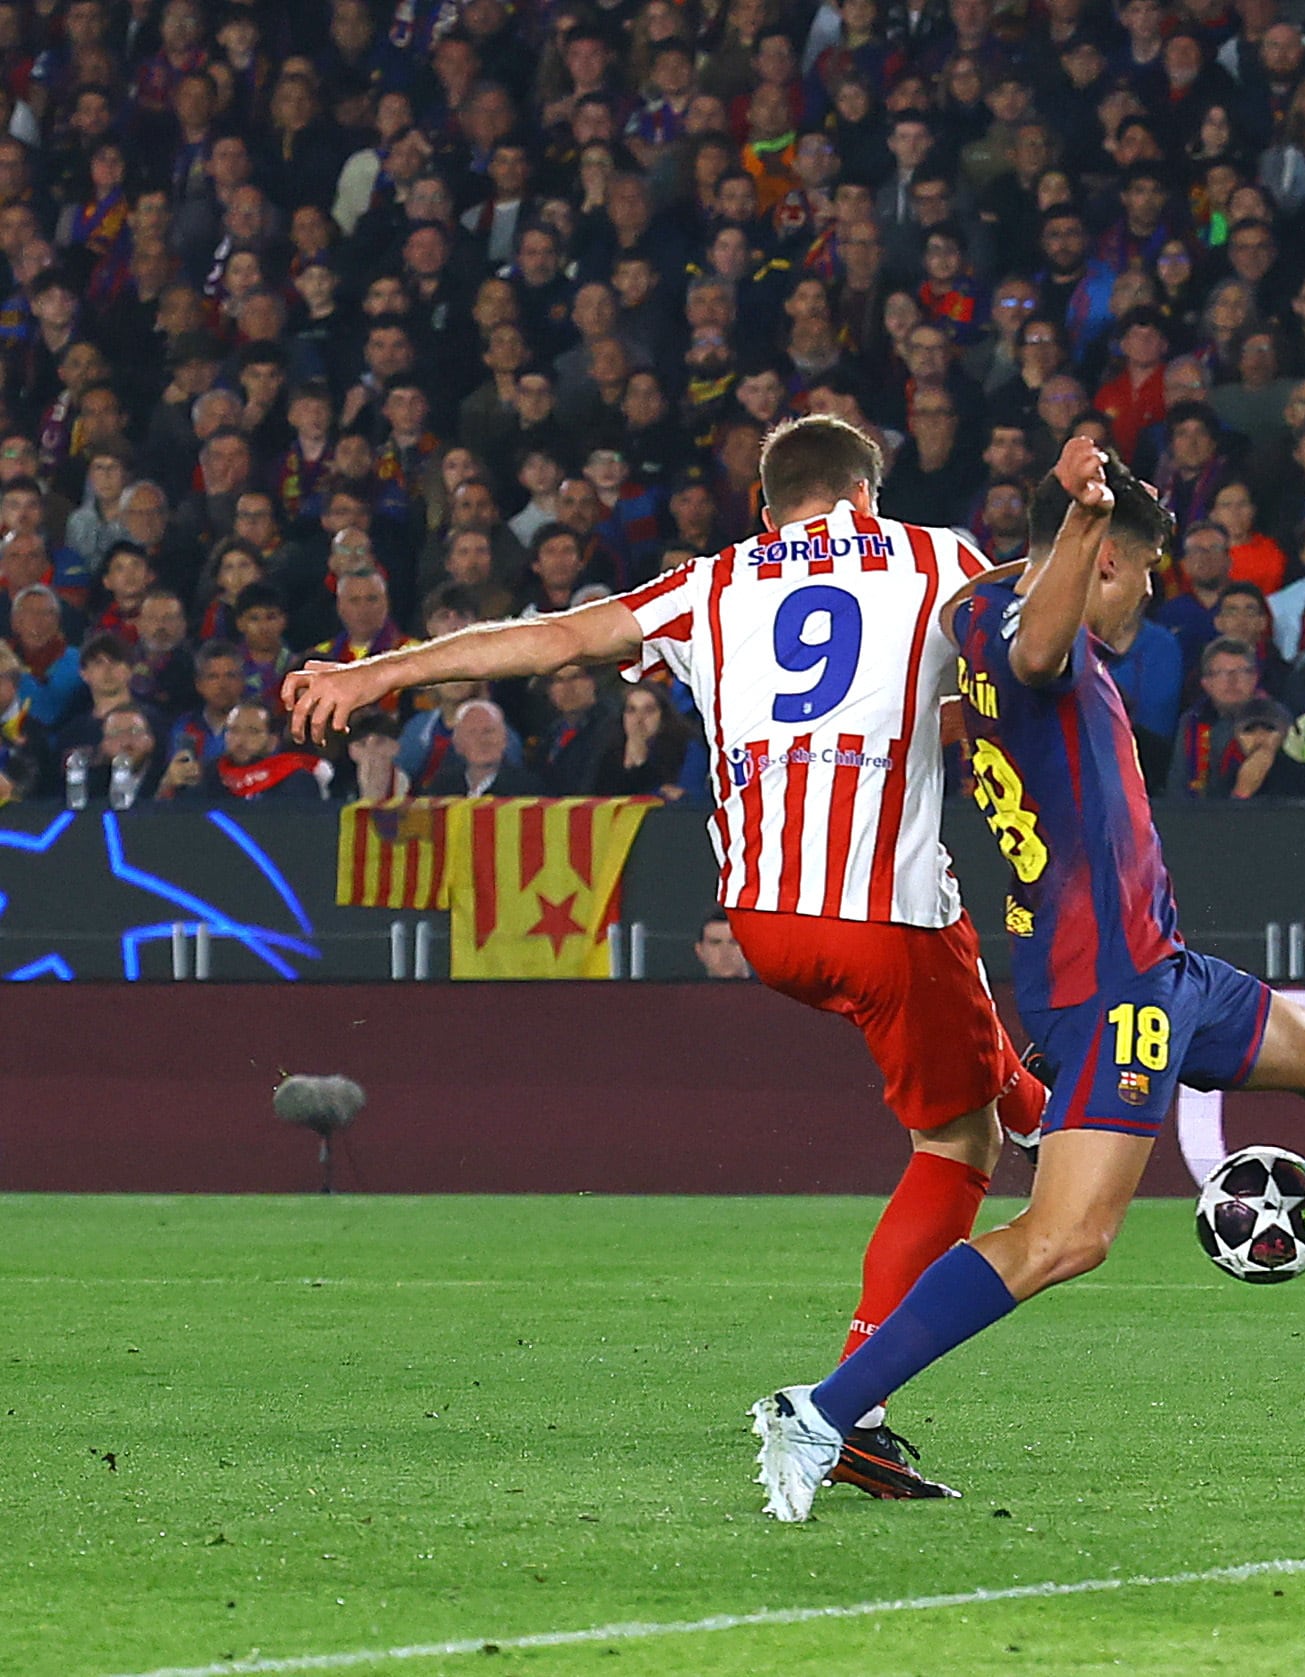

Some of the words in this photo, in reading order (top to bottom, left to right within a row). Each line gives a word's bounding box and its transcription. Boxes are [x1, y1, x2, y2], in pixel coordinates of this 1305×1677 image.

[748, 535, 895, 566] SØRLOTH
[772, 584, 863, 724] 9
[758, 753, 788, 772] Se
[791, 747, 818, 764] the
[822, 748, 893, 770] Children
[1108, 1003, 1170, 1071] 18
